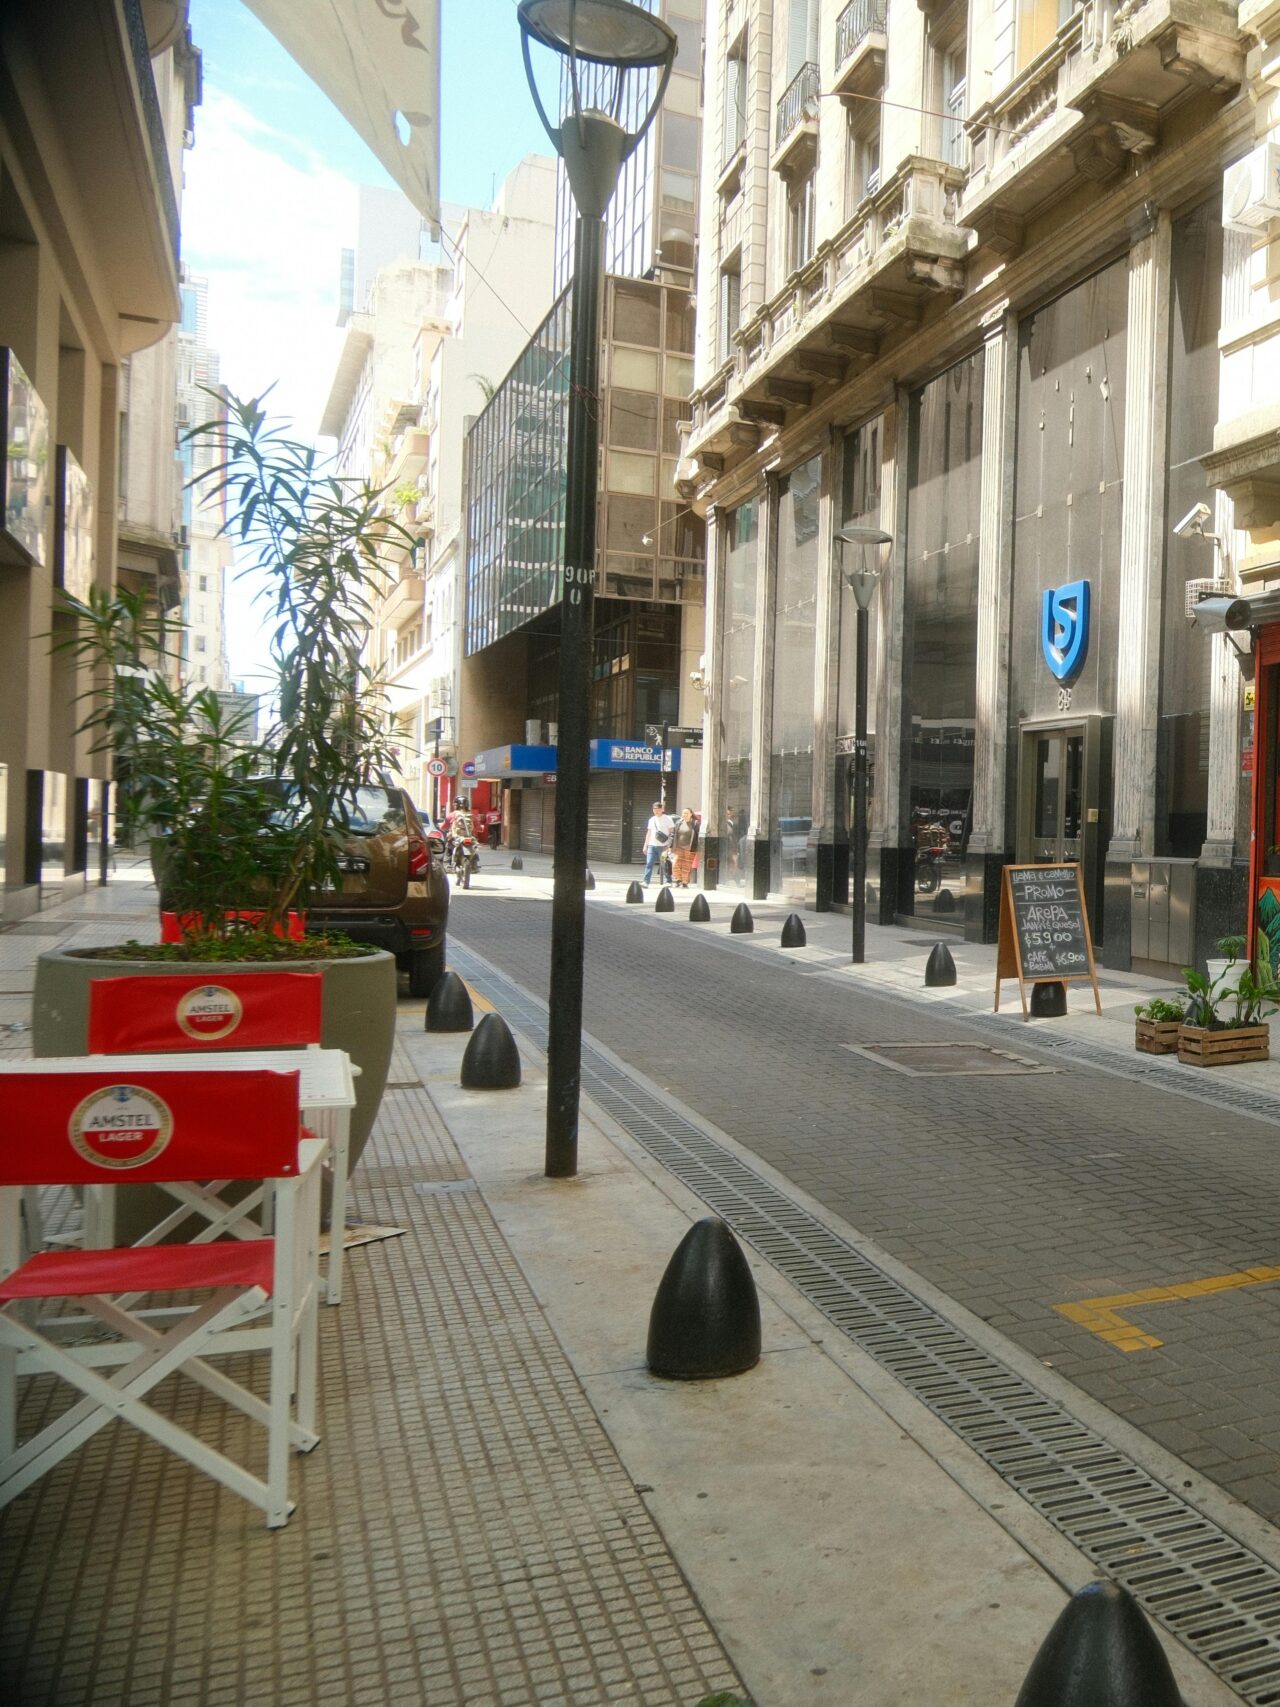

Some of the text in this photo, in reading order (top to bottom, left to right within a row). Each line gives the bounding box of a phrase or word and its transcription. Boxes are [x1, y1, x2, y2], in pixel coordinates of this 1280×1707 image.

[625, 746, 653, 754] BANCO
[625, 753, 662, 761] REPUBLIC
[189, 1004, 230, 1013] AMSTEL
[89, 1114, 153, 1128] AMSTEL
[99, 1132, 144, 1142] LAGER
